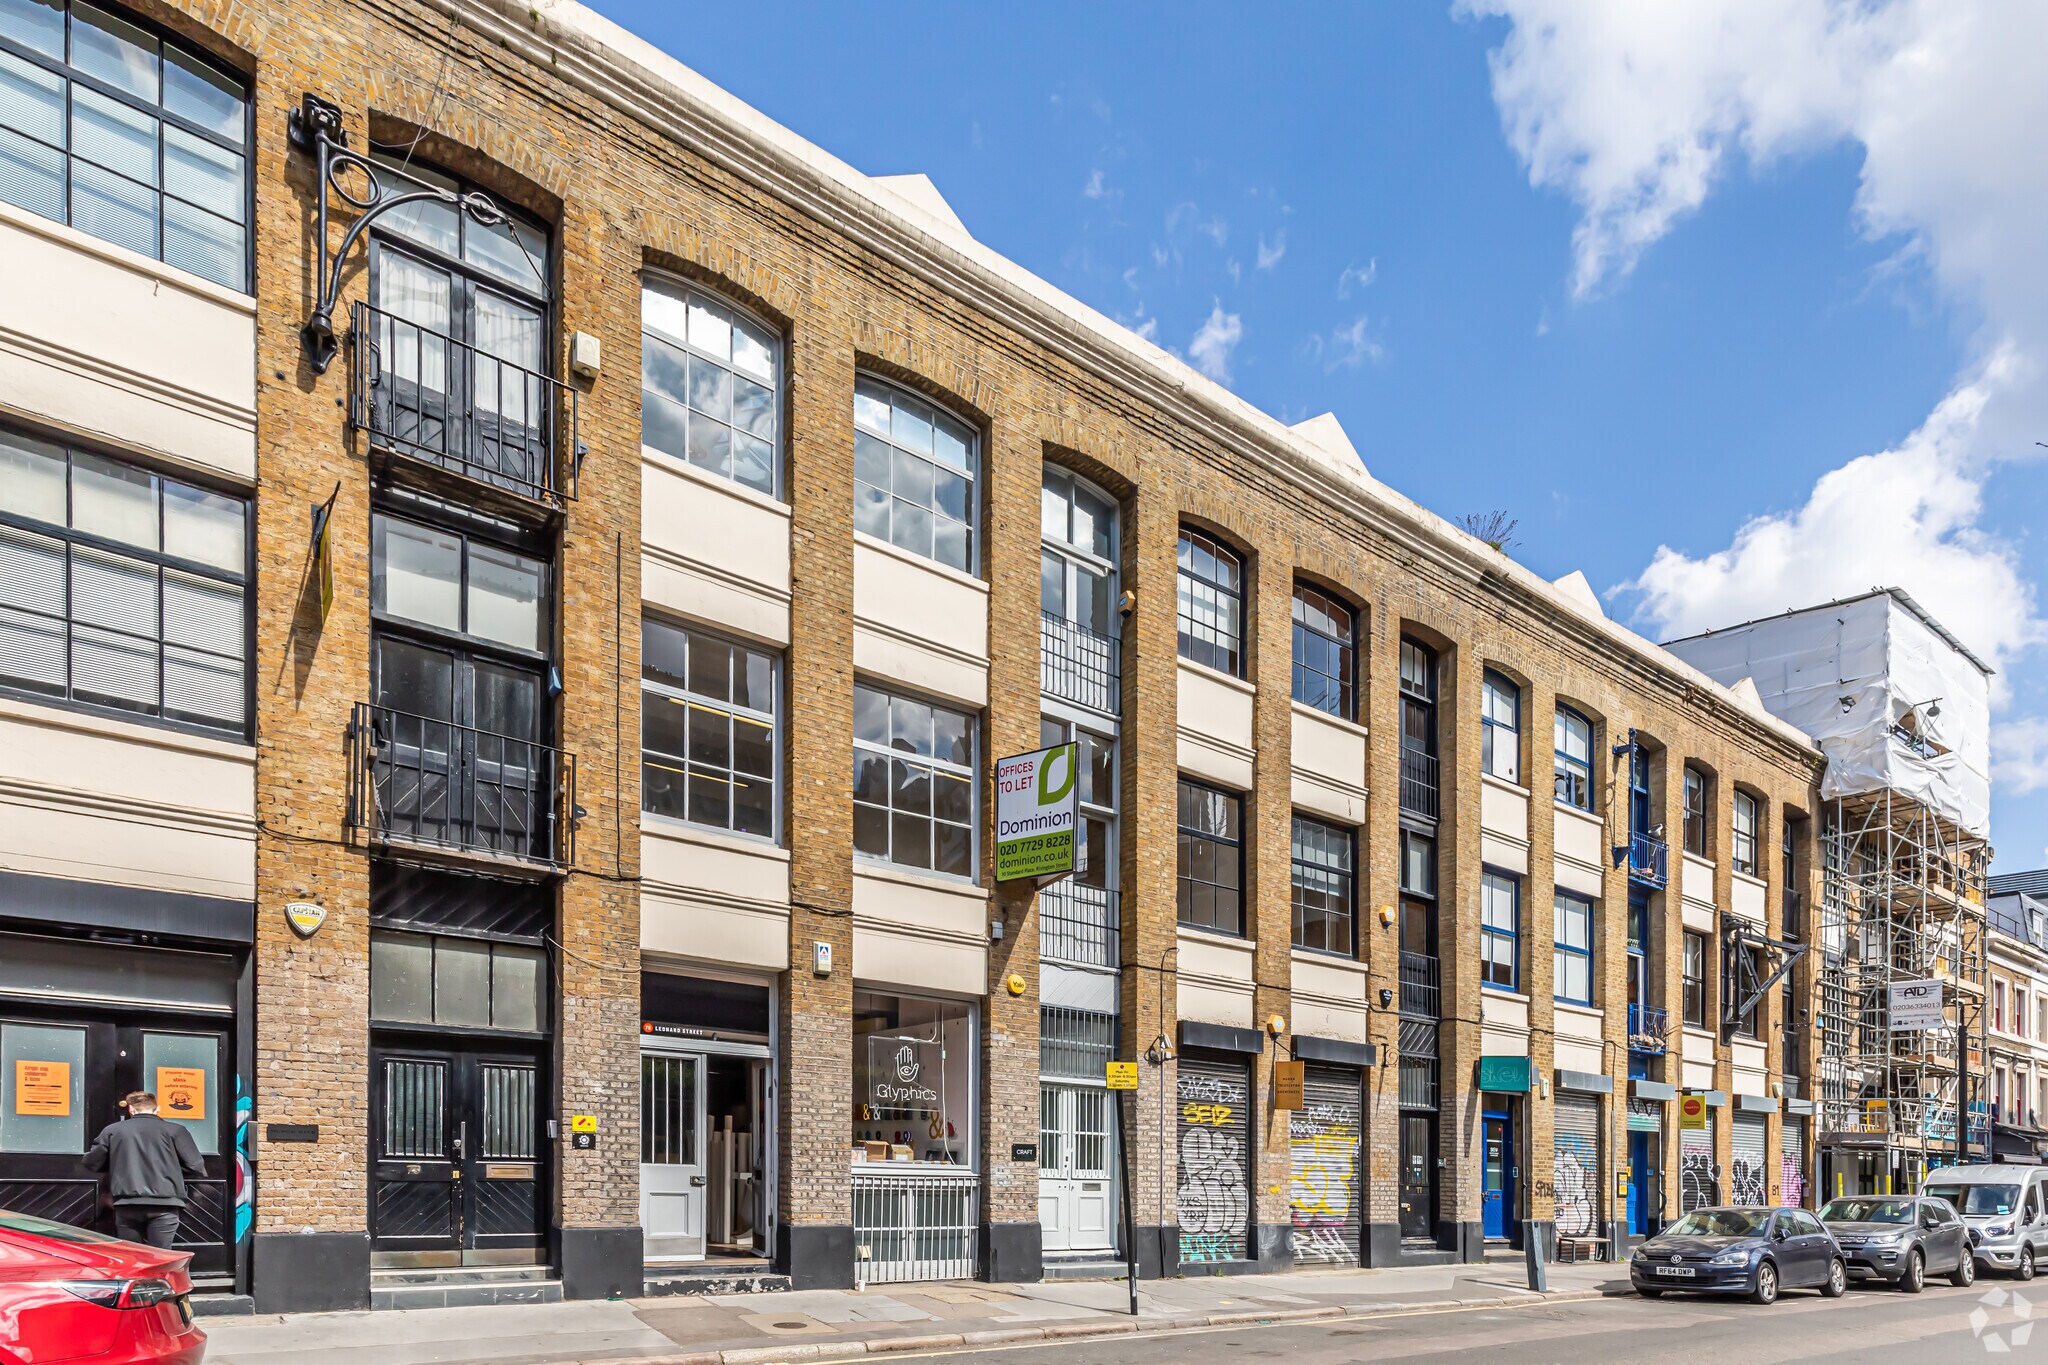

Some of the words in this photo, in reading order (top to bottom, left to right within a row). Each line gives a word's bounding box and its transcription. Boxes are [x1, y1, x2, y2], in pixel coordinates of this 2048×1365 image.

[1000, 761, 1034, 778] OFFICES
[1000, 781, 1013, 794] TO
[1015, 776, 1034, 791] LET
[1000, 811, 1072, 836] Dominion
[1000, 843, 1017, 856] 020
[1020, 838, 1043, 852] 7729
[1046, 834, 1071, 848] 8228
[1000, 848, 1068, 869] dominion.co.uk
[1892, 1002, 1941, 1011] 02036334013
[654, 1025, 681, 1033] LEONARD
[876, 1084, 938, 1102] Glyphics
[1771, 1184, 1780, 1196] 81
[1659, 1267, 1677, 1275] RF64
